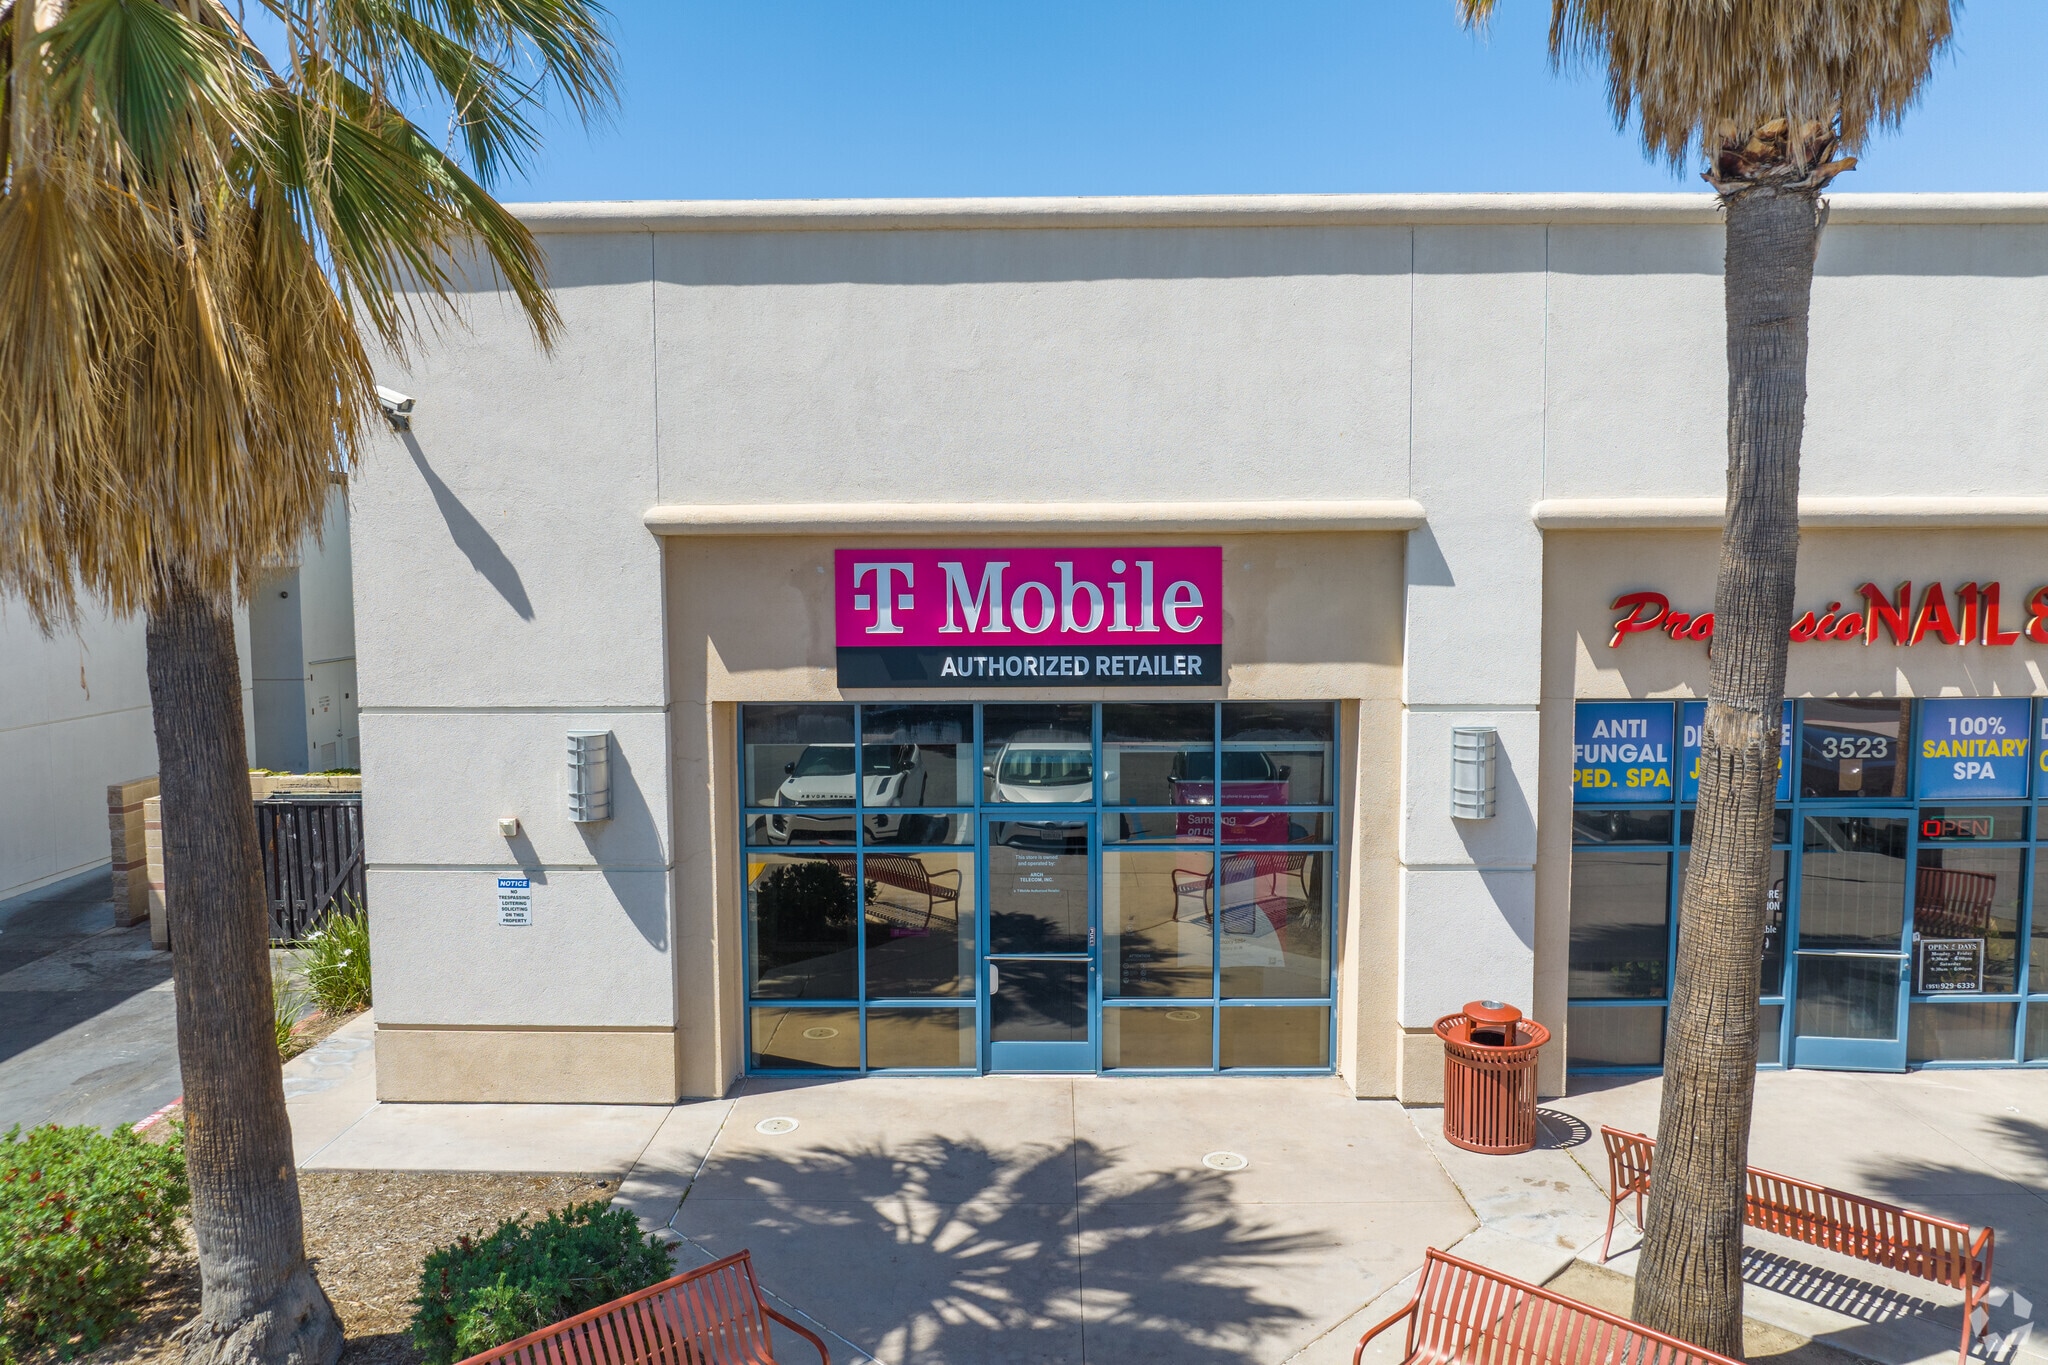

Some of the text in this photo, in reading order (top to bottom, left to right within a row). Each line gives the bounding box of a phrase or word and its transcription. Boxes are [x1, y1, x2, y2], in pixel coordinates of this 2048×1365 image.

[938, 559, 1204, 634] Mobile
[940, 654, 1203, 677] AUTHORIZED RETAILER
[1592, 719, 1647, 738] ANTI
[1948, 716, 2006, 736] 100%
[1573, 743, 1668, 763] FUNGAL
[1822, 737, 1888, 759] 3523
[1922, 738, 2029, 759] SANITARY
[1625, 768, 1671, 787] SPA
[1953, 761, 1996, 780] SPA
[1923, 819, 1988, 837] OPEN
